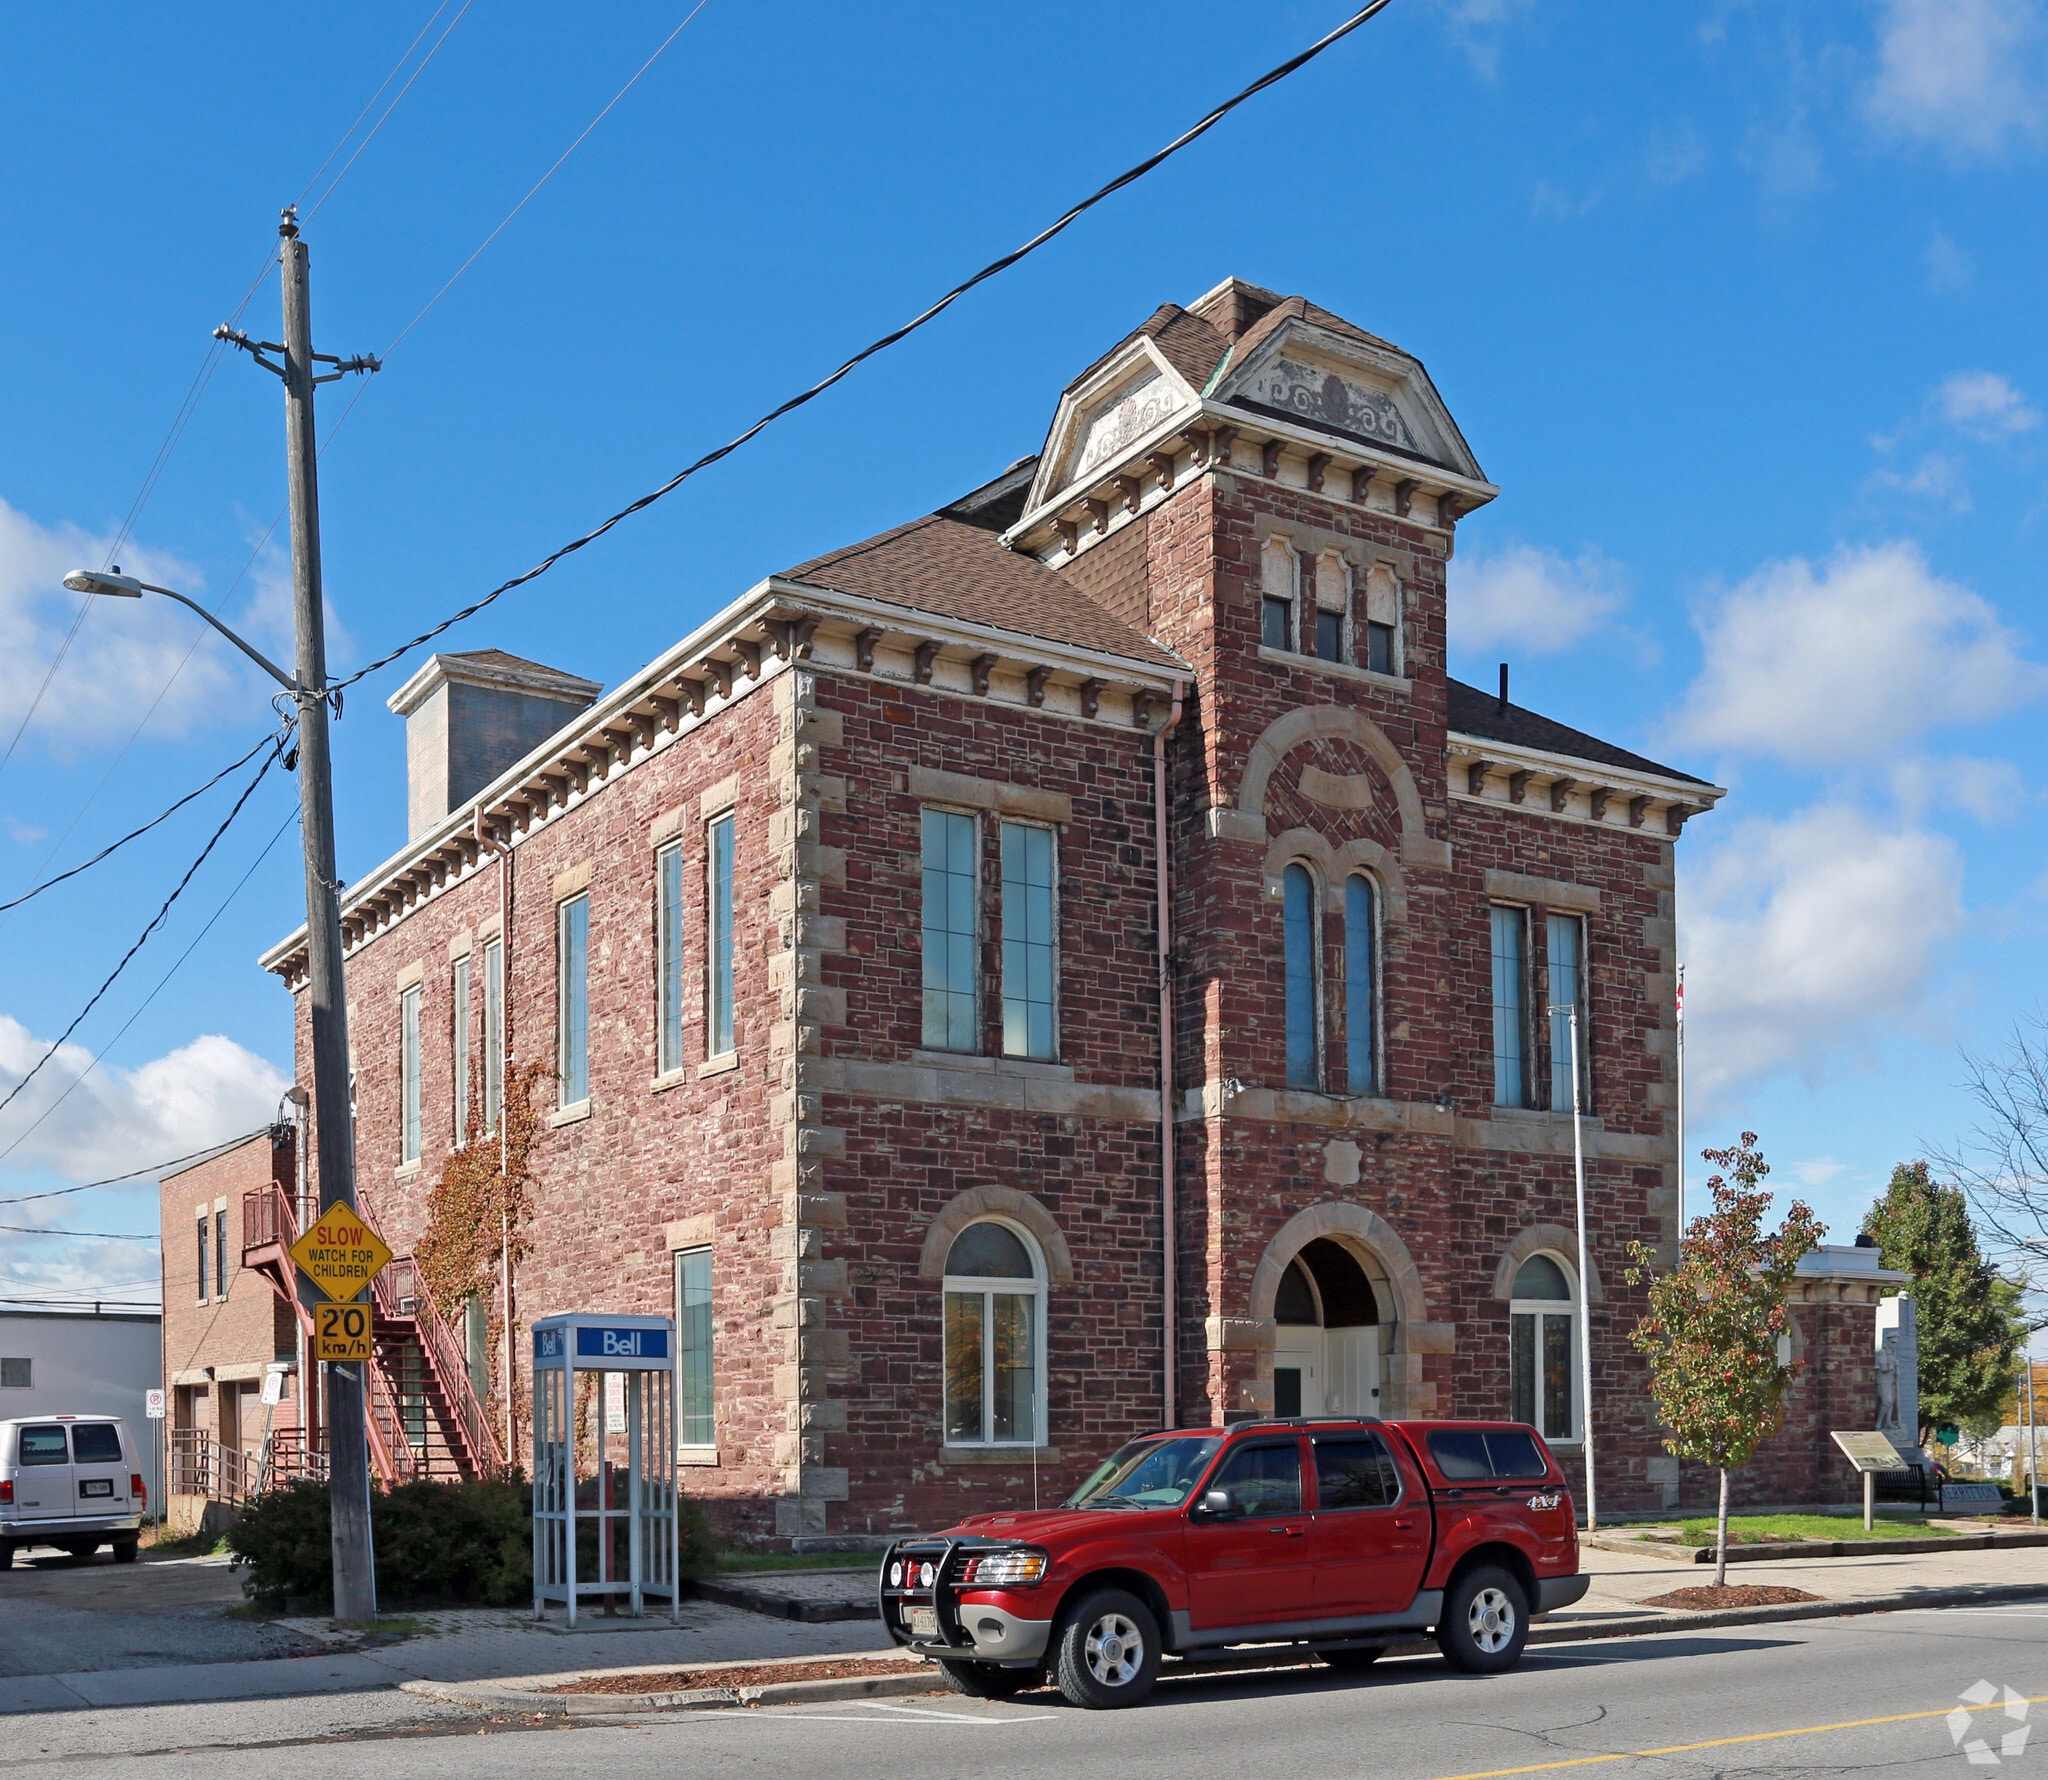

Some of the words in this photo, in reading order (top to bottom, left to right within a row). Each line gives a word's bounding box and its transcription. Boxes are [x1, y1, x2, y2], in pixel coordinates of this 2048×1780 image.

[317, 1226, 363, 1246] SLOW
[308, 1249, 346, 1262] WATCH
[351, 1250, 374, 1263] FOR
[313, 1264, 368, 1278] CHILDREN
[322, 1308, 365, 1338] 20
[322, 1339, 366, 1357] km/h
[542, 1330, 556, 1356] Bell
[603, 1330, 641, 1356] Bell
